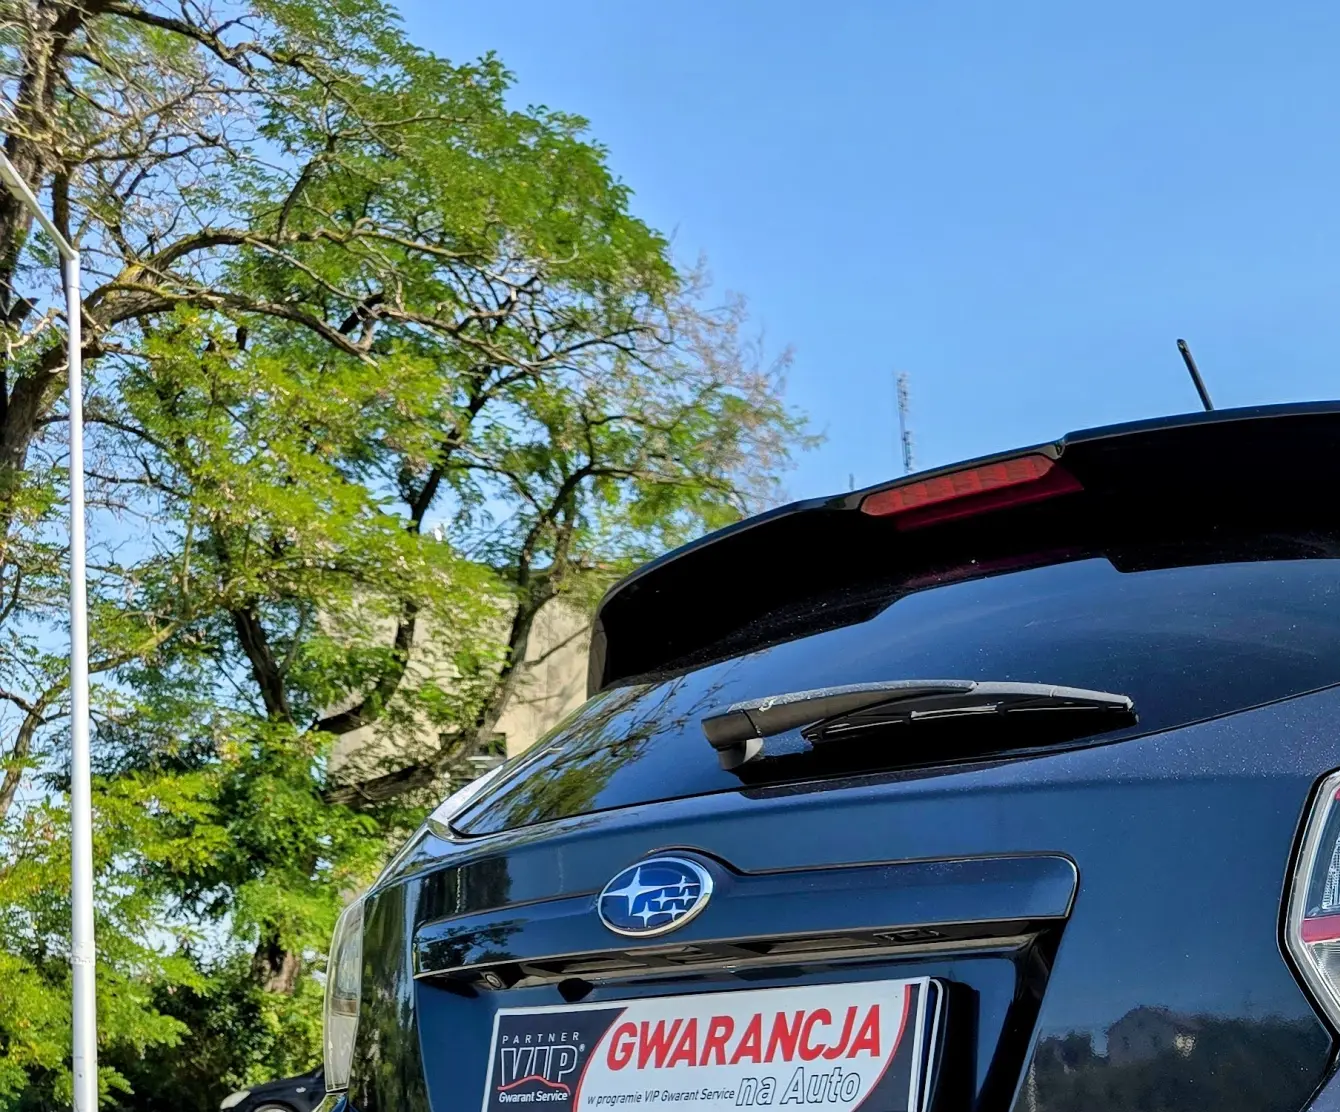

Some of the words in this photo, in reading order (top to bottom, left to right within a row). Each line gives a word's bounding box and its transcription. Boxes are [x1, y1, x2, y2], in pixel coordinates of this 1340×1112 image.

[502, 1031, 580, 1044] PARTNER
[606, 1004, 880, 1071] GWARANCJA
[499, 1091, 536, 1103] Gwarant
[536, 1089, 568, 1101] Service
[735, 1076, 776, 1106] na
[780, 1066, 861, 1106] Auto
[596, 1092, 642, 1107] programie
[644, 1091, 660, 1102] VIP
[660, 1088, 698, 1101] Gwarant
[700, 1087, 735, 1100] Service
